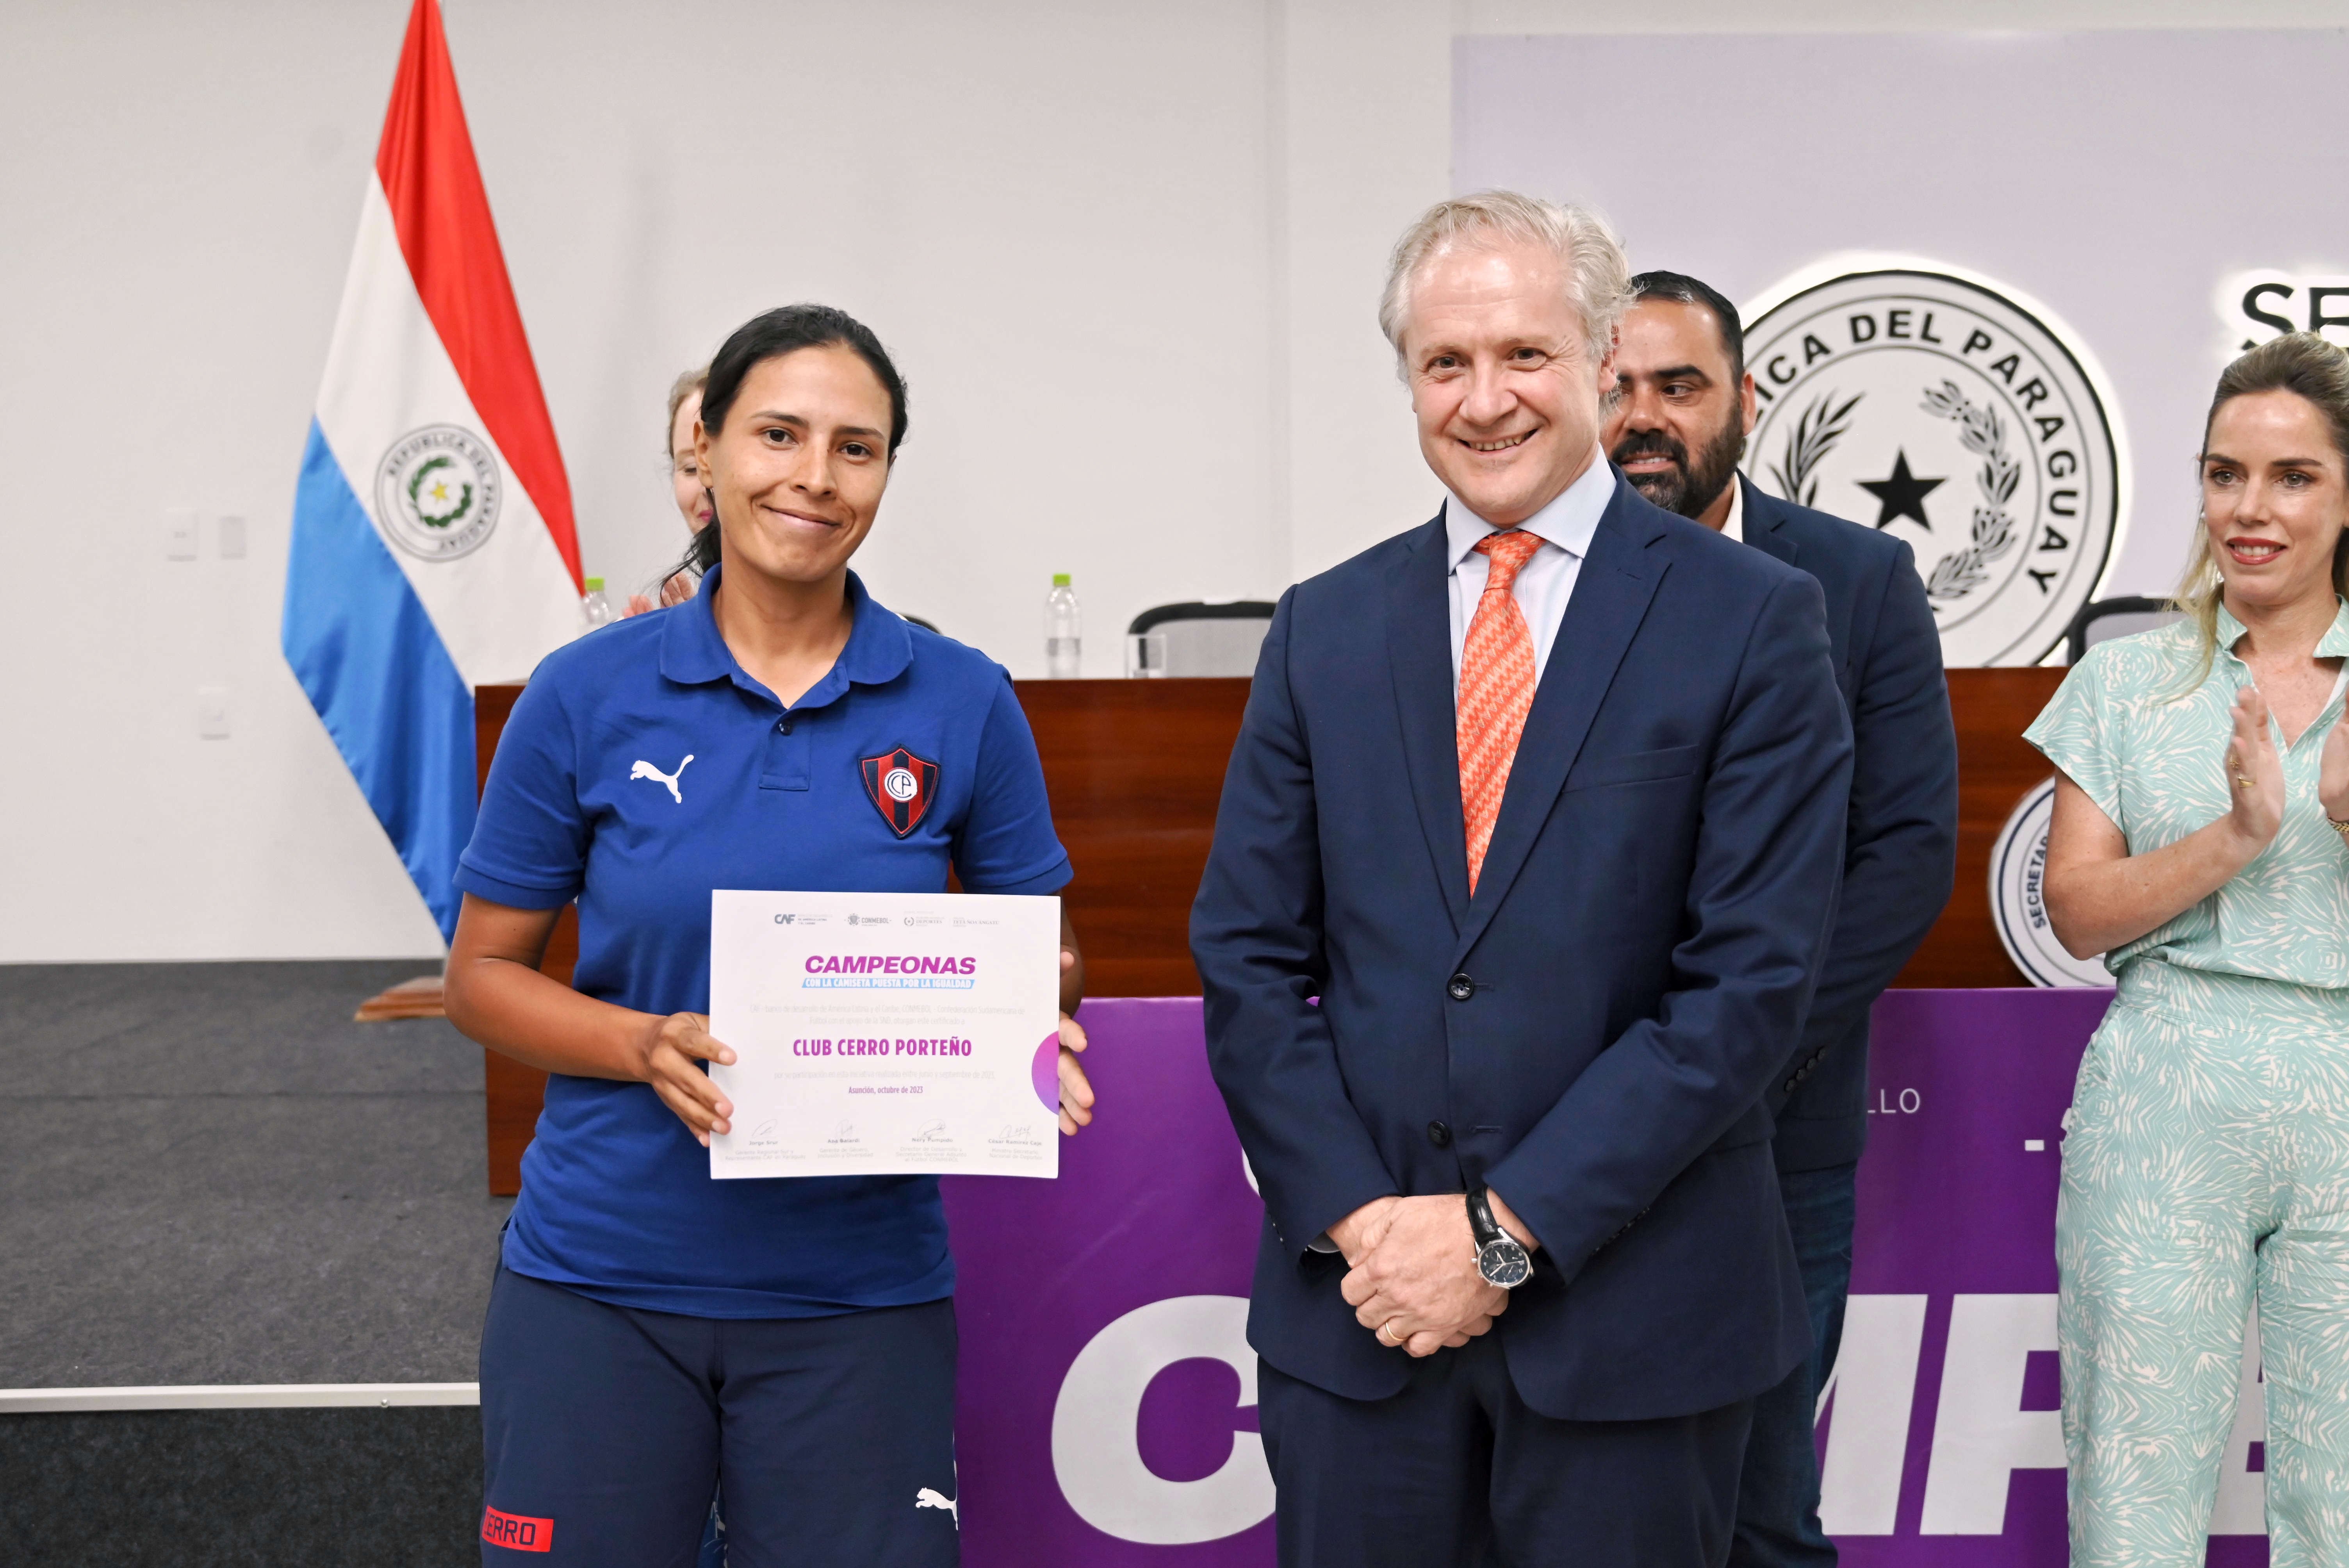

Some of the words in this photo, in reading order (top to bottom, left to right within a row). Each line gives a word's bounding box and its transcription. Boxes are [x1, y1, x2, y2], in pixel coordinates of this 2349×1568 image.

[469, 449, 489, 476] DEL
[1755, 333, 1831, 424] ICA
[1849, 310, 1941, 344] DEL
[1962, 329, 2078, 595] PARAGUAY
[440, 485, 492, 550] PARAGUAY
[774, 914, 796, 925] CAF
[805, 955, 977, 975] CAMPEONAS
[806, 978, 820, 987] CON
[822, 978, 832, 987] LA
[834, 978, 871, 987] CAMISETA
[872, 979, 901, 987] PUESTA
[903, 979, 919, 987] POR
[921, 979, 931, 988] LA
[932, 979, 971, 988] IGUALDAD
[978, 1006, 1017, 1014] Sudamericana
[793, 1039, 832, 1056] CLUB
[838, 1039, 890, 1056] CERRO
[895, 1036, 972, 1056] PORTEÑO
[848, 1085, 876, 1095] Asunción,
[877, 1086, 900, 1094] octubre
[1868, 1088, 1921, 1114] LO
